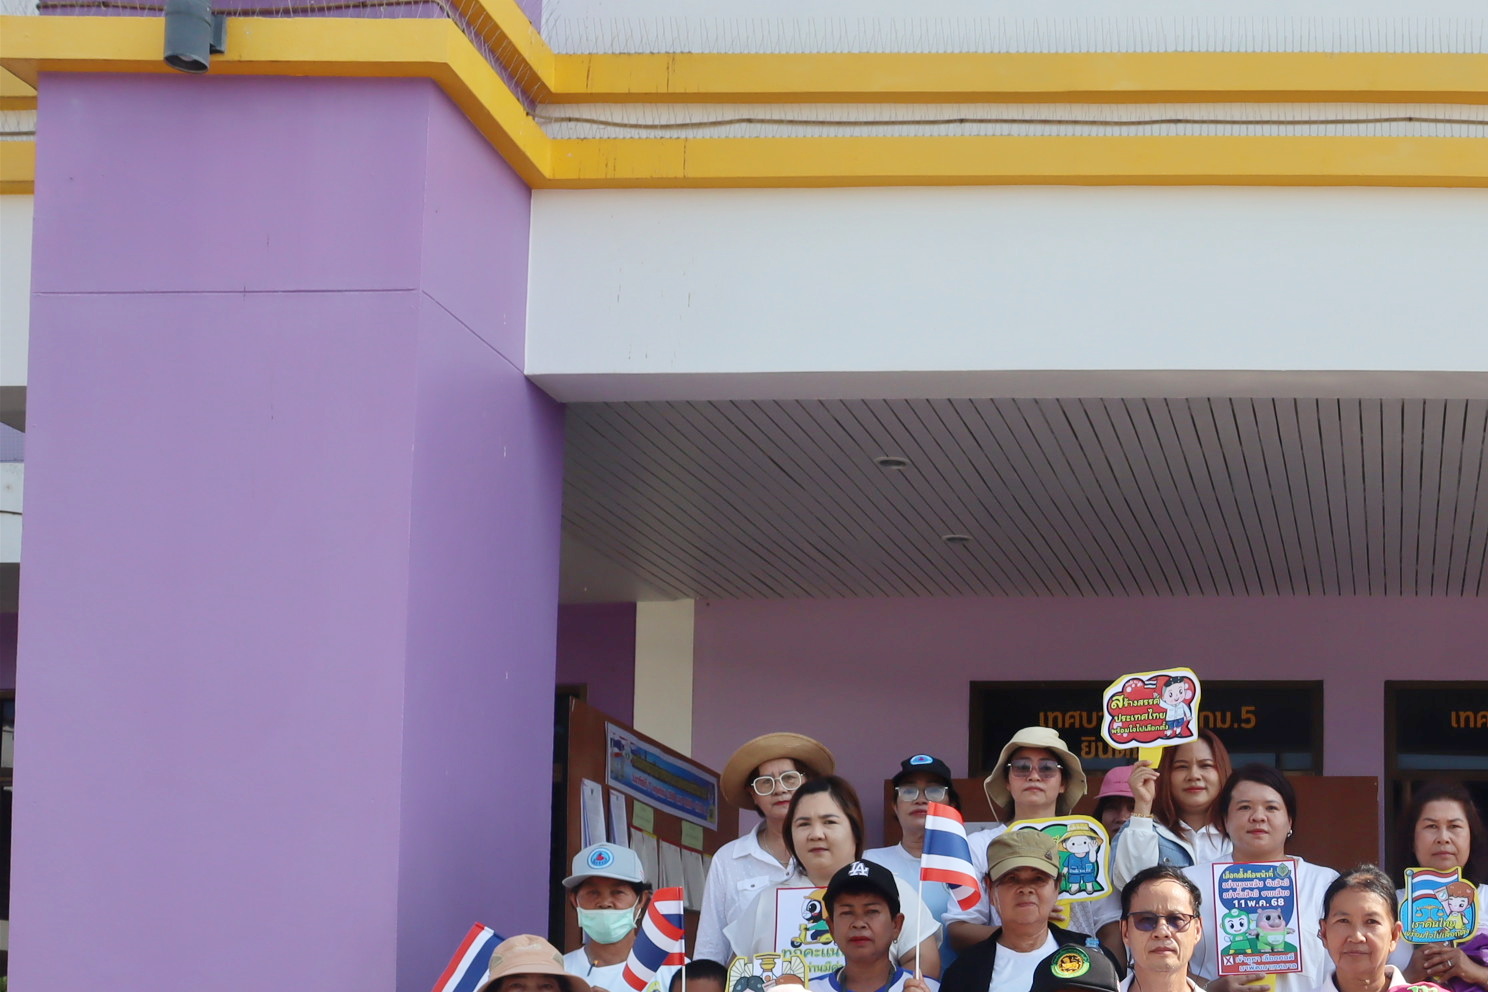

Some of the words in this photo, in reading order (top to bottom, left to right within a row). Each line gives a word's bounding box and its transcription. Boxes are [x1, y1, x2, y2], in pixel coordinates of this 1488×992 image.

[1110, 694, 1161, 710] สร้างสรรค์
[1114, 708, 1166, 724] ประเทศไทย
[1110, 721, 1169, 735] พร้อมใจไปเลือกตั้ง
[848, 861, 870, 878] LA
[1233, 900, 1245, 908] 11
[1247, 899, 1269, 908] พ.ค.
[1271, 898, 1285, 906] 68
